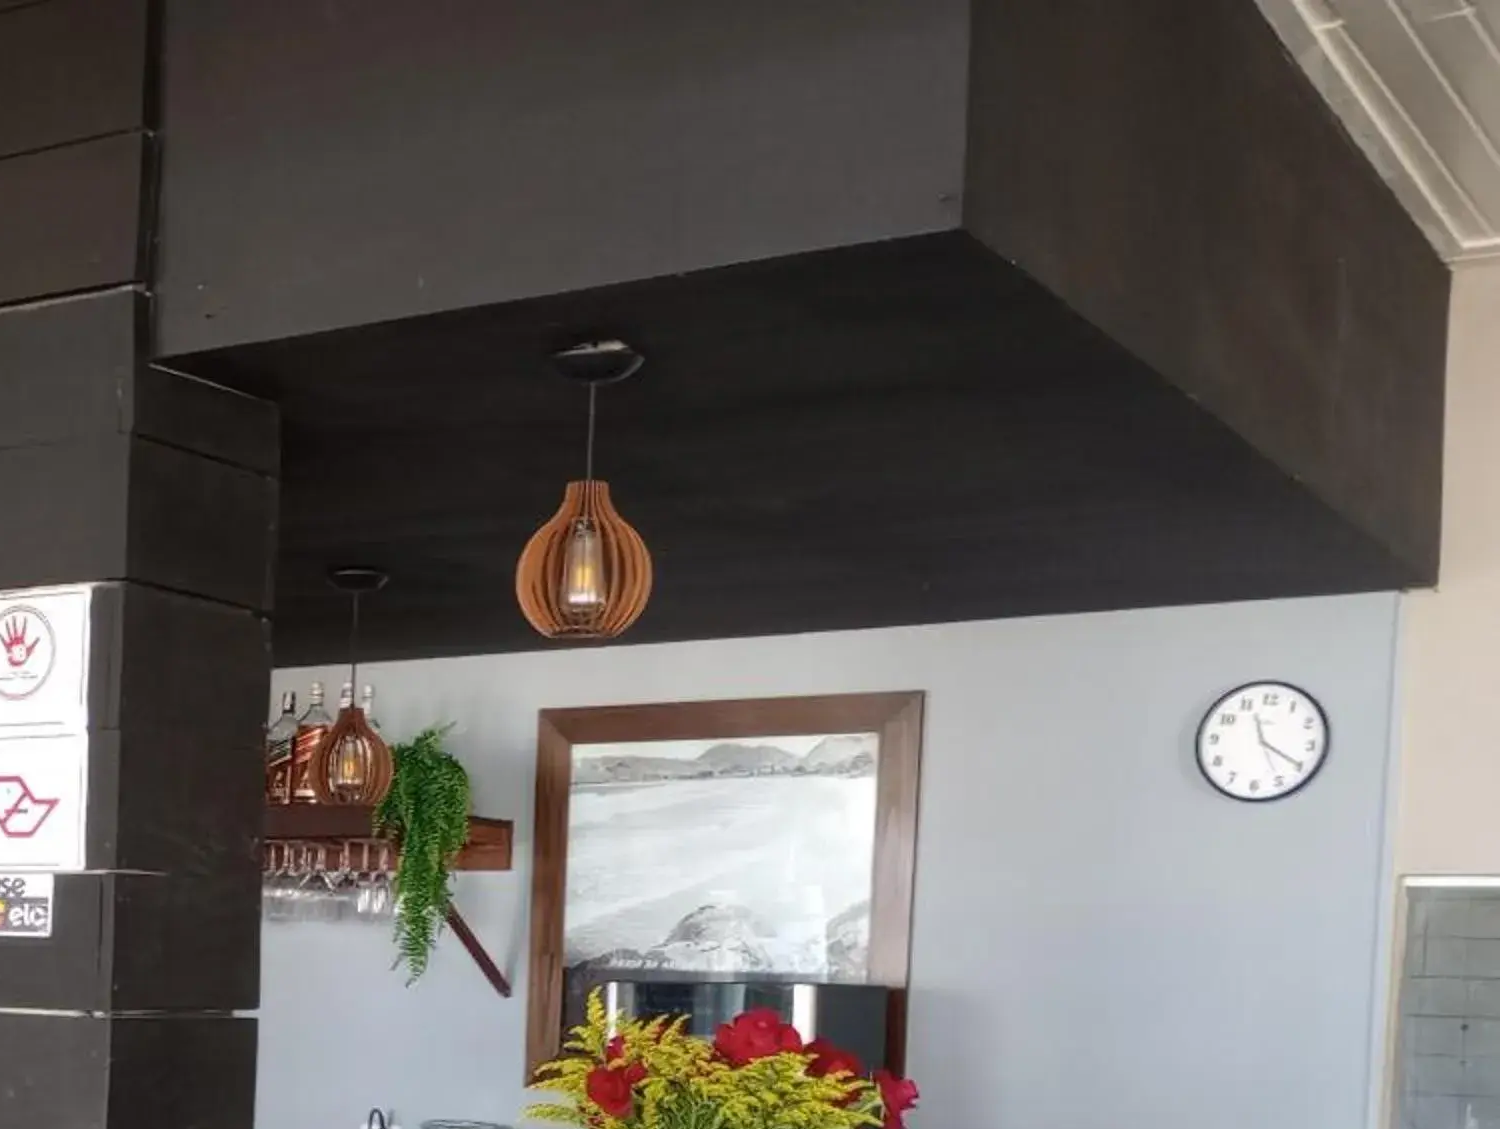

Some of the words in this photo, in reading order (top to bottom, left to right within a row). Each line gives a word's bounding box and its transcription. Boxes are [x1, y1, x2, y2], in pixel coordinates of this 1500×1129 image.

[1262, 693, 1279, 706] 12
[1220, 713, 1236, 725] 10
[1209, 733, 1219, 745] 9
